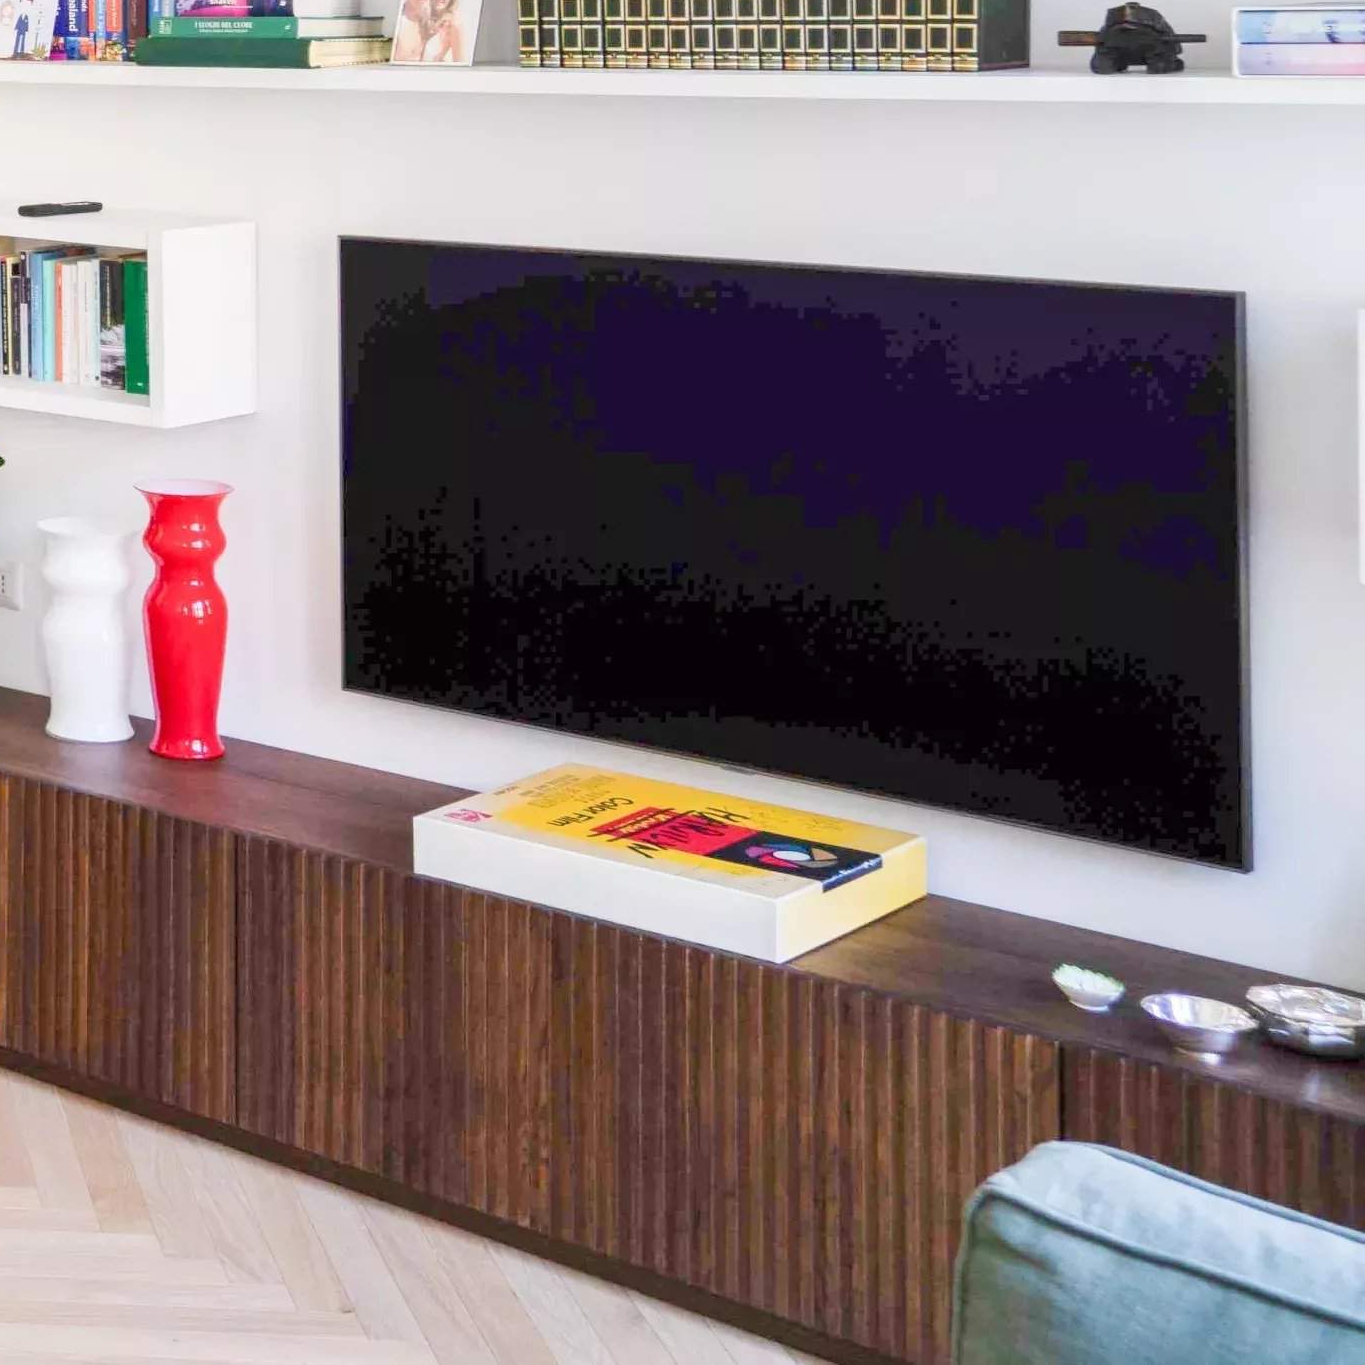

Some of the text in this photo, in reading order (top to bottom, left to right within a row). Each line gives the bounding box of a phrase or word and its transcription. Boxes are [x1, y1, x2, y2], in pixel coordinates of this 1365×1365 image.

[220, 21, 232, 29] DEL
[548, 797, 635, 828] Color Film
